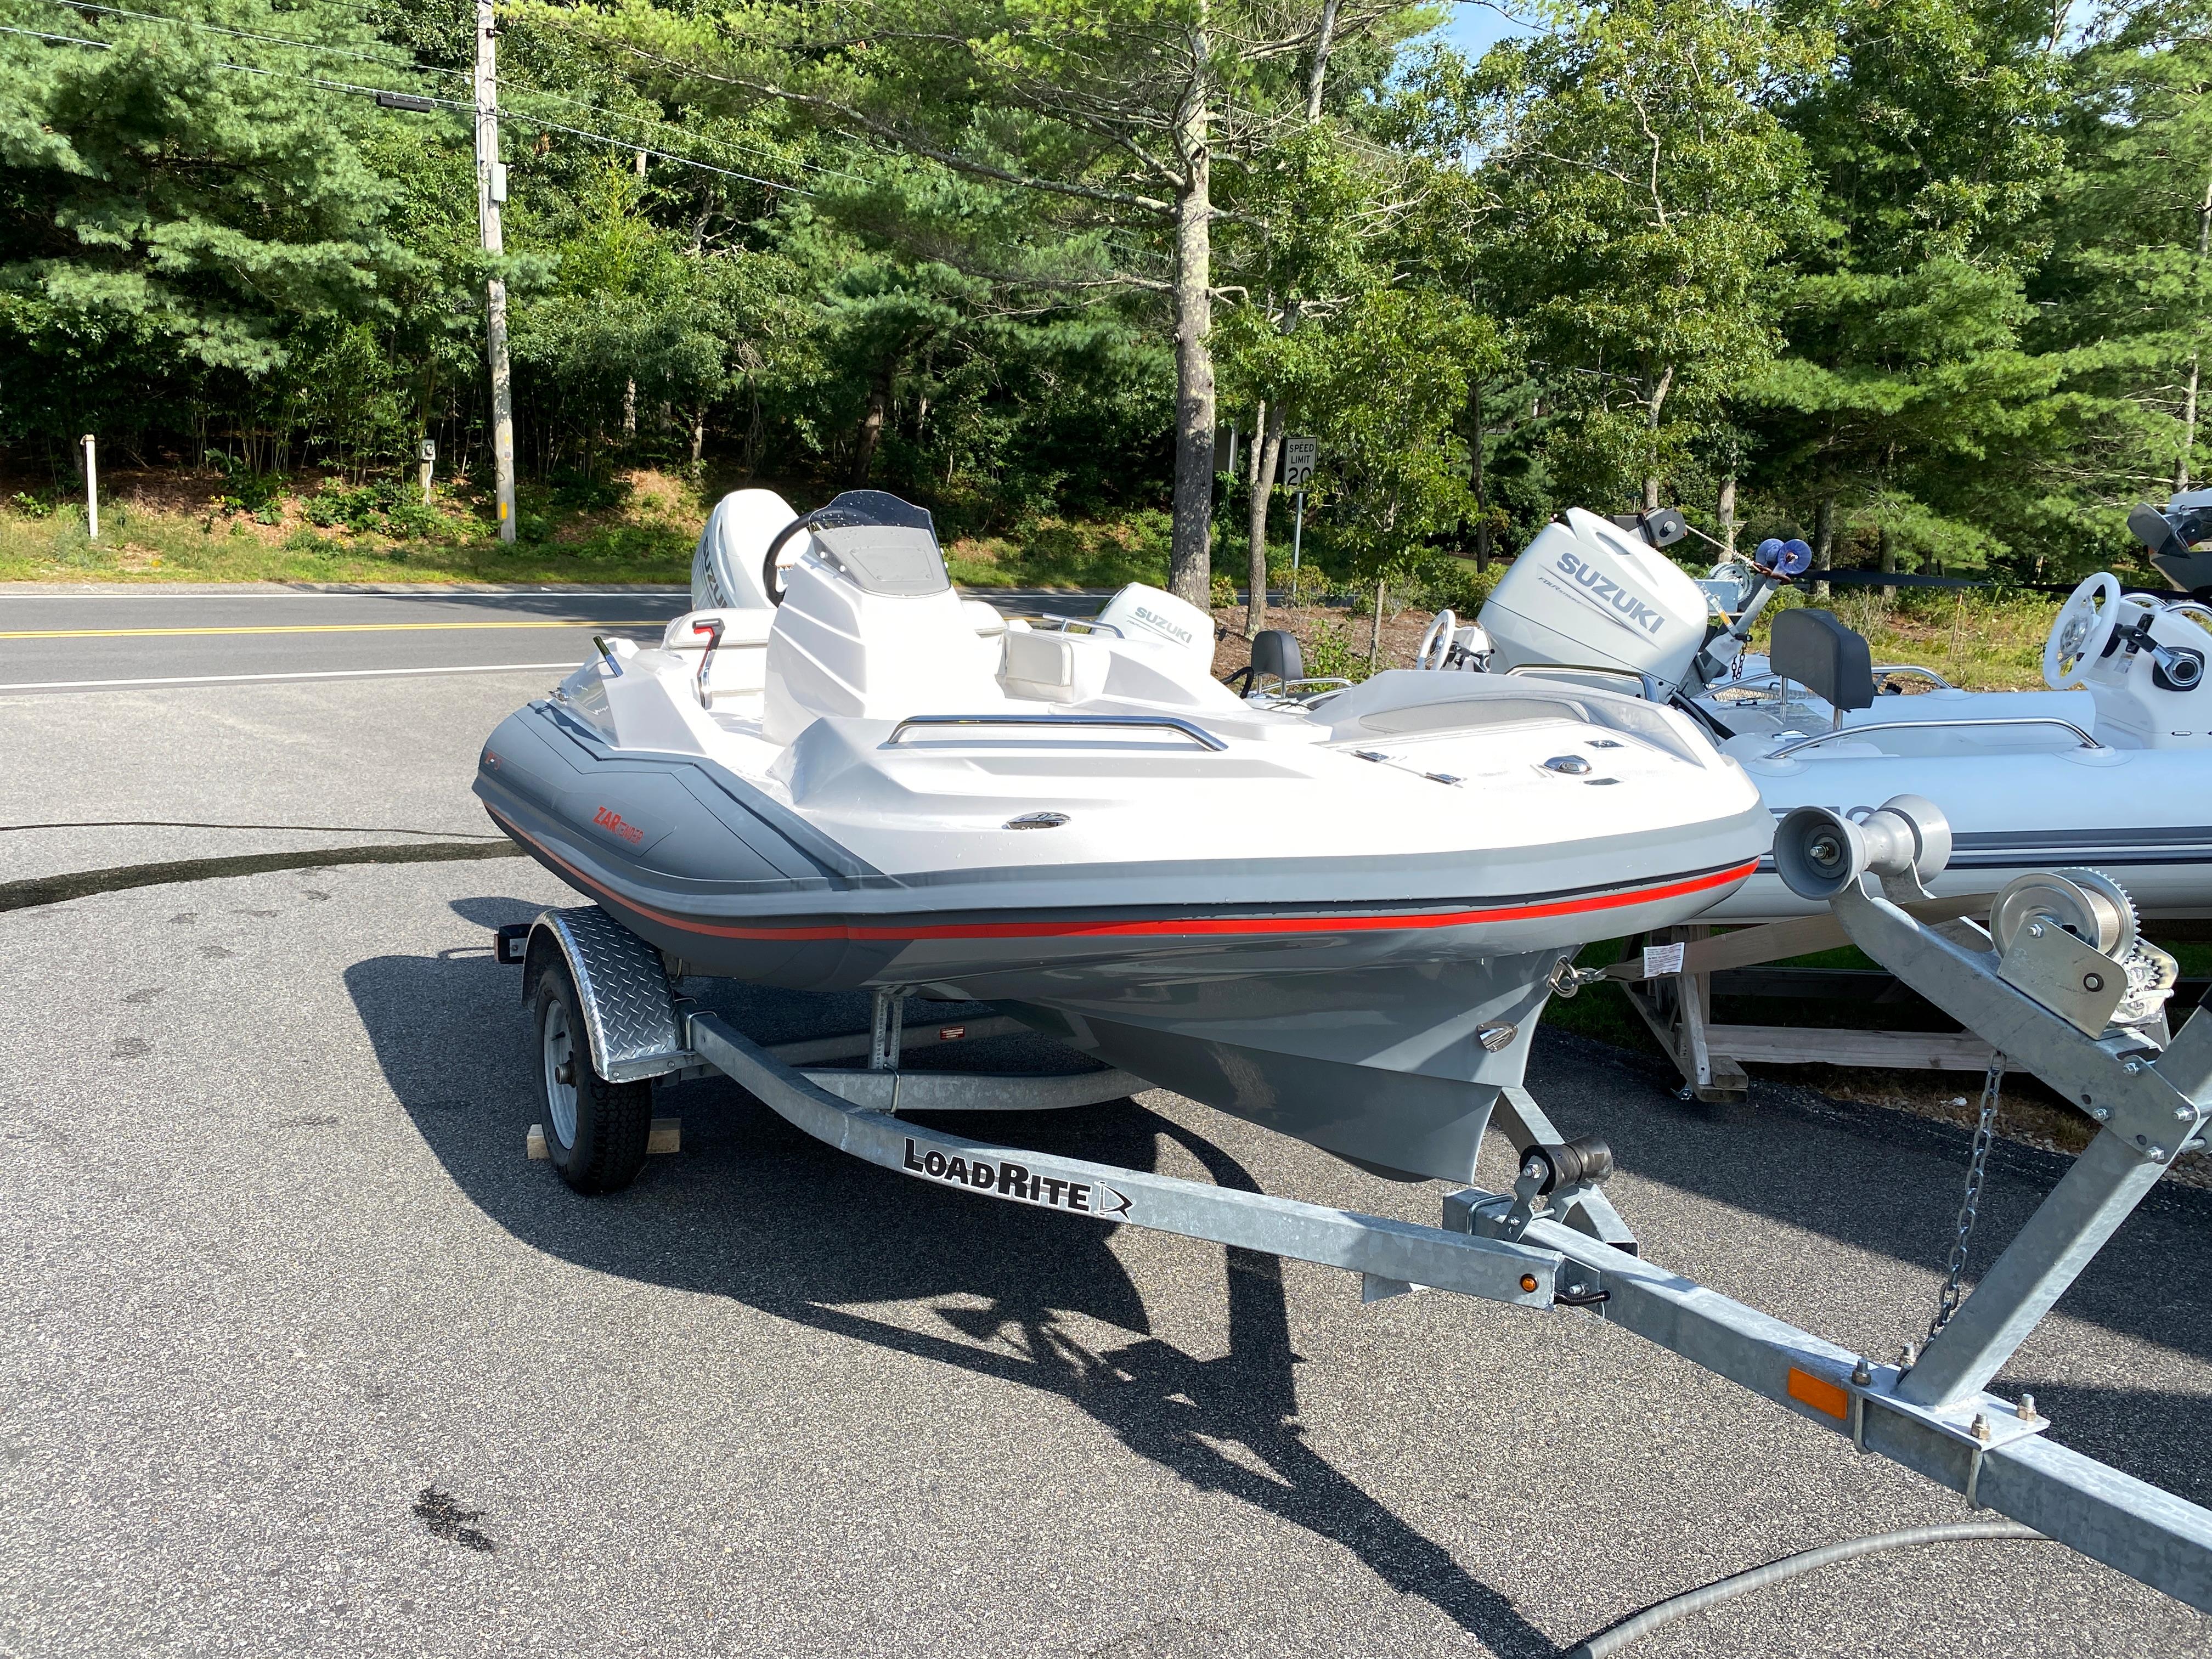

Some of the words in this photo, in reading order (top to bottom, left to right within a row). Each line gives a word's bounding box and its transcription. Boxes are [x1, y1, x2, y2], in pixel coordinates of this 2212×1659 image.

[1289, 444, 1314, 453] SPEED
[1291, 455, 1311, 464] LIMIT
[1287, 466, 1312, 486] 20
[1538, 577, 1560, 591] FOUR
[1556, 552, 1666, 634] SUZUKI
[1135, 607, 1193, 644] SUZUKI
[902, 1137, 1093, 1215] LOADRITE
